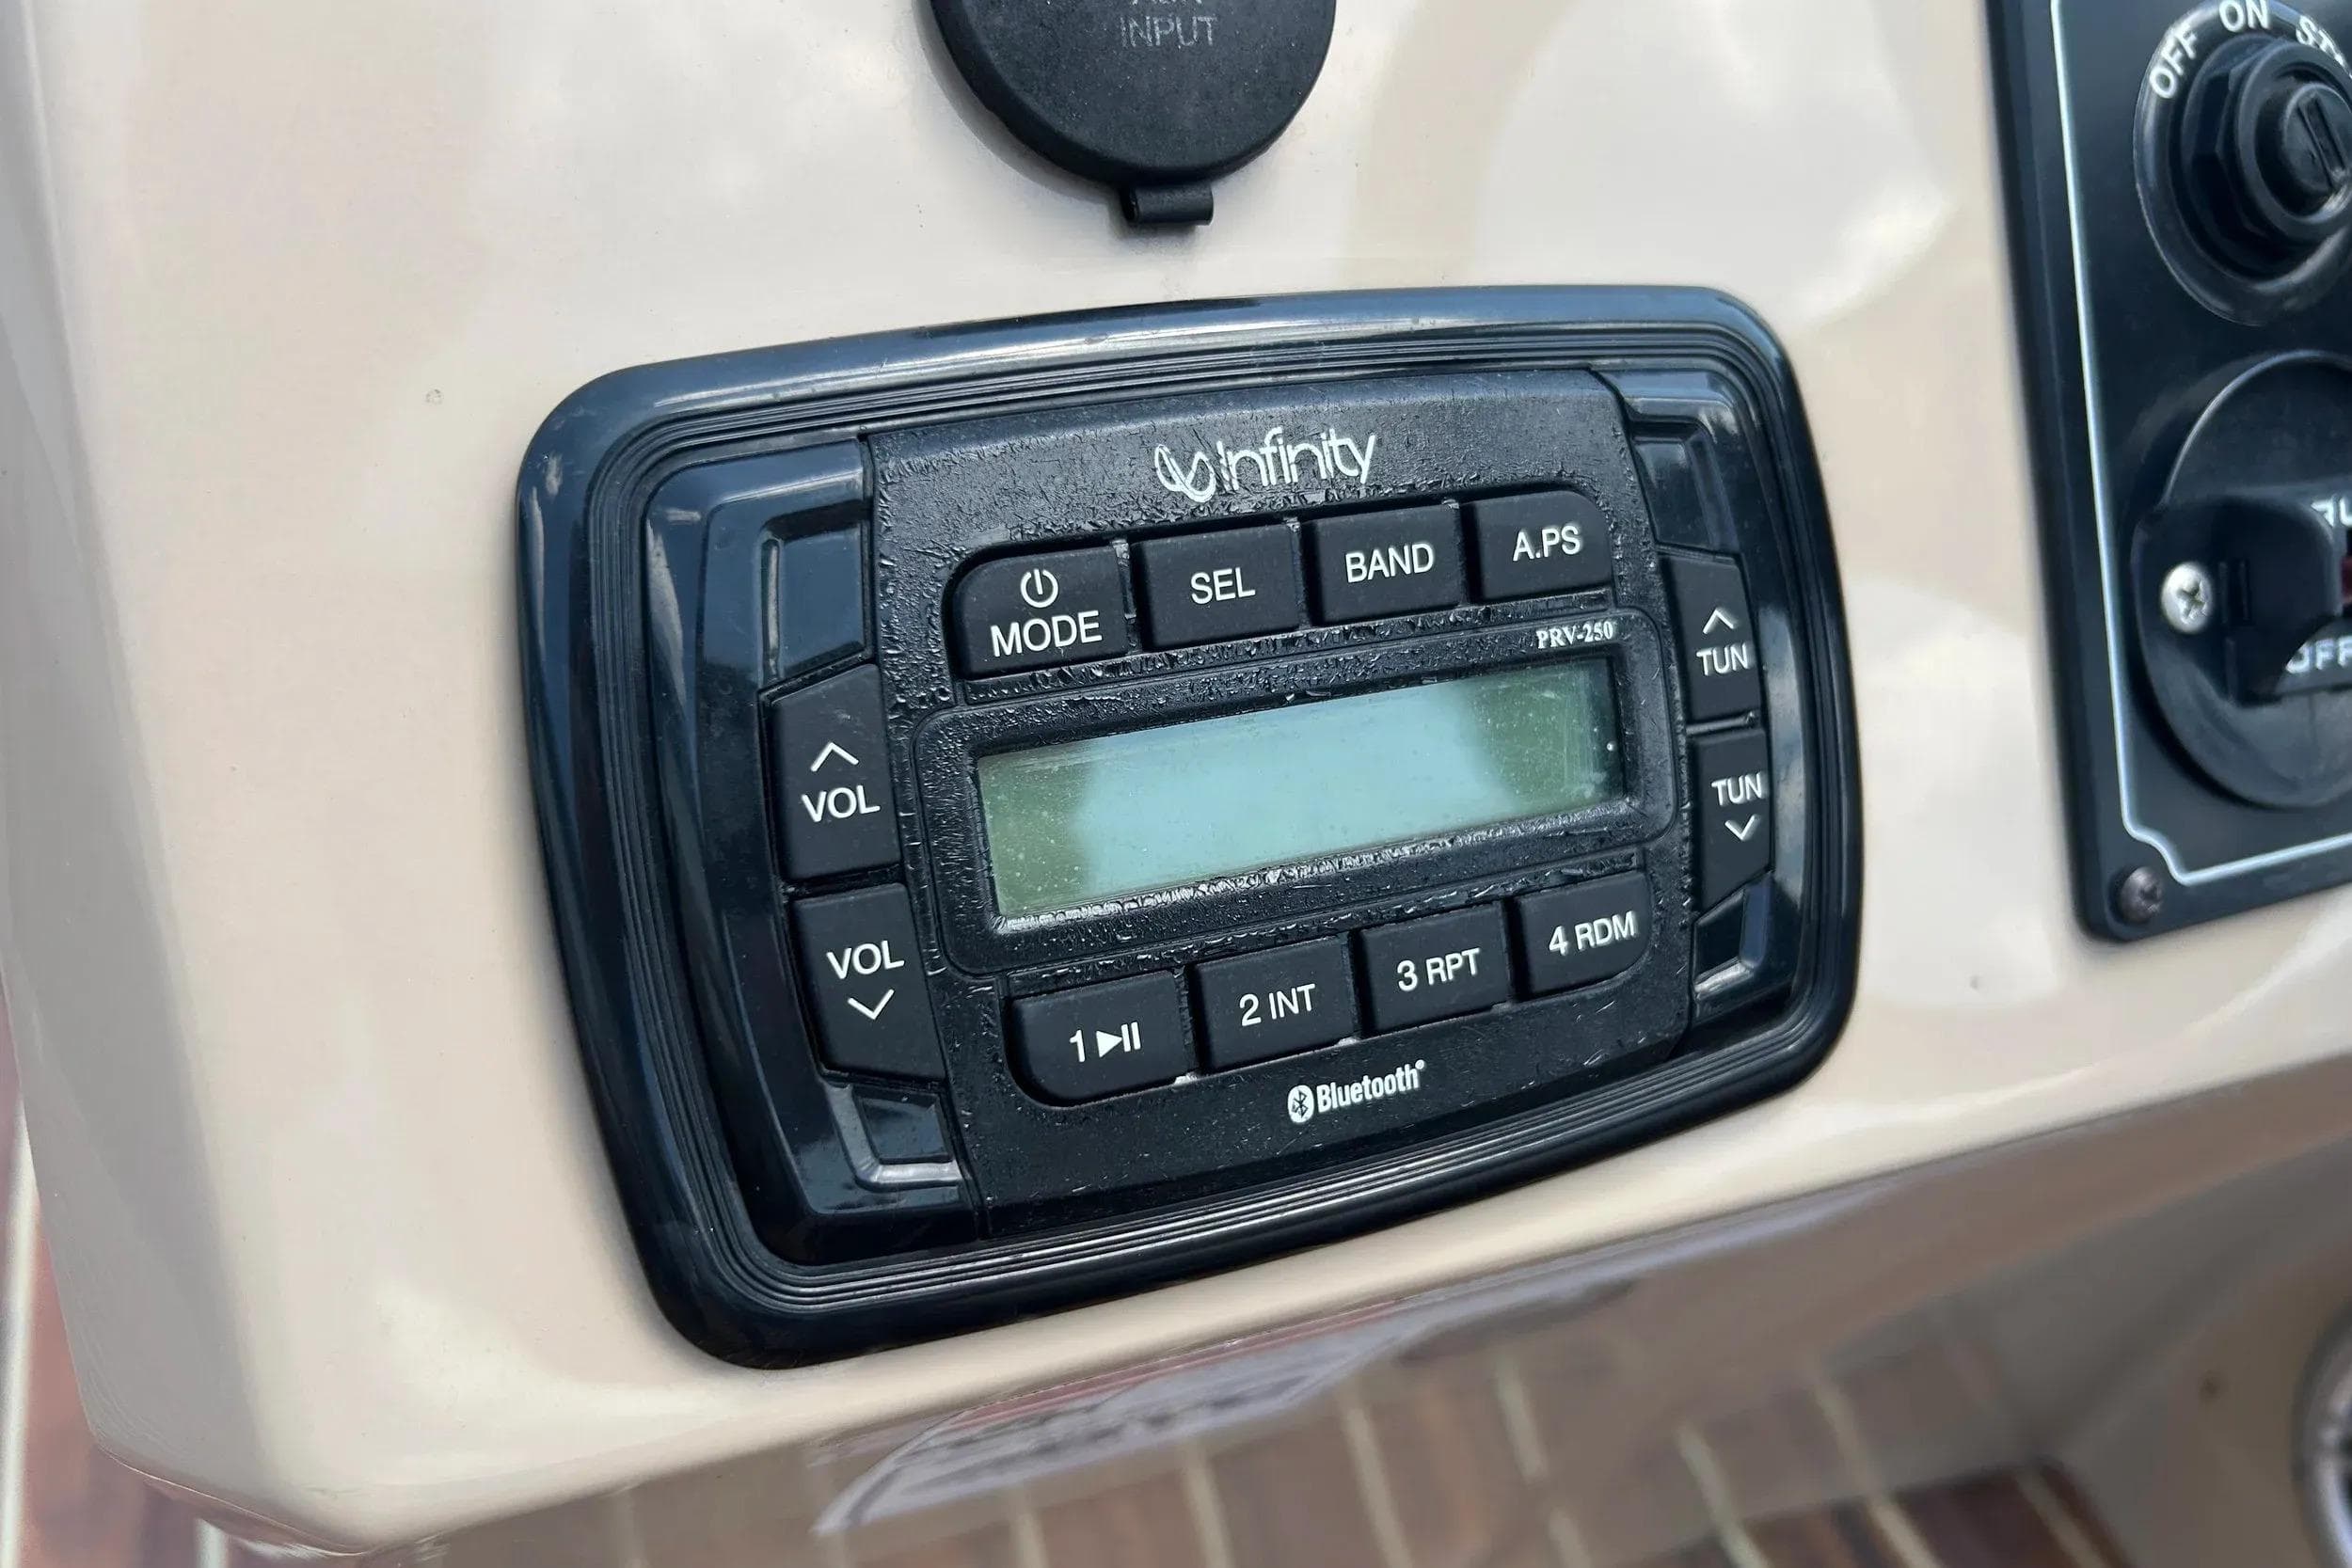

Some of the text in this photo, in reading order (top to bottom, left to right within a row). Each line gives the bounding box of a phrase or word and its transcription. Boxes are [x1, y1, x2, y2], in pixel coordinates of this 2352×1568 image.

[1120, 16, 1217, 48] INPUT
[2218, 0, 2272, 33] ON
[2149, 24, 2199, 99] OFF
[1513, 523, 1581, 562] A.PS
[1345, 543, 1435, 583] BAND
[1190, 569, 1256, 604] SEL
[990, 610, 1103, 657] MODE
[1536, 621, 1614, 649] PRV-250
[1696, 642, 1749, 676] TUN
[802, 784, 881, 823] VOL
[1711, 772, 1765, 806] TUN
[1549, 911, 1636, 956] 4 RDM
[826, 940, 905, 979] VOL
[1397, 947, 1480, 991] 3 RPT
[1239, 983, 1316, 1026] 2 INT
[1069, 1029, 1086, 1063] 1
